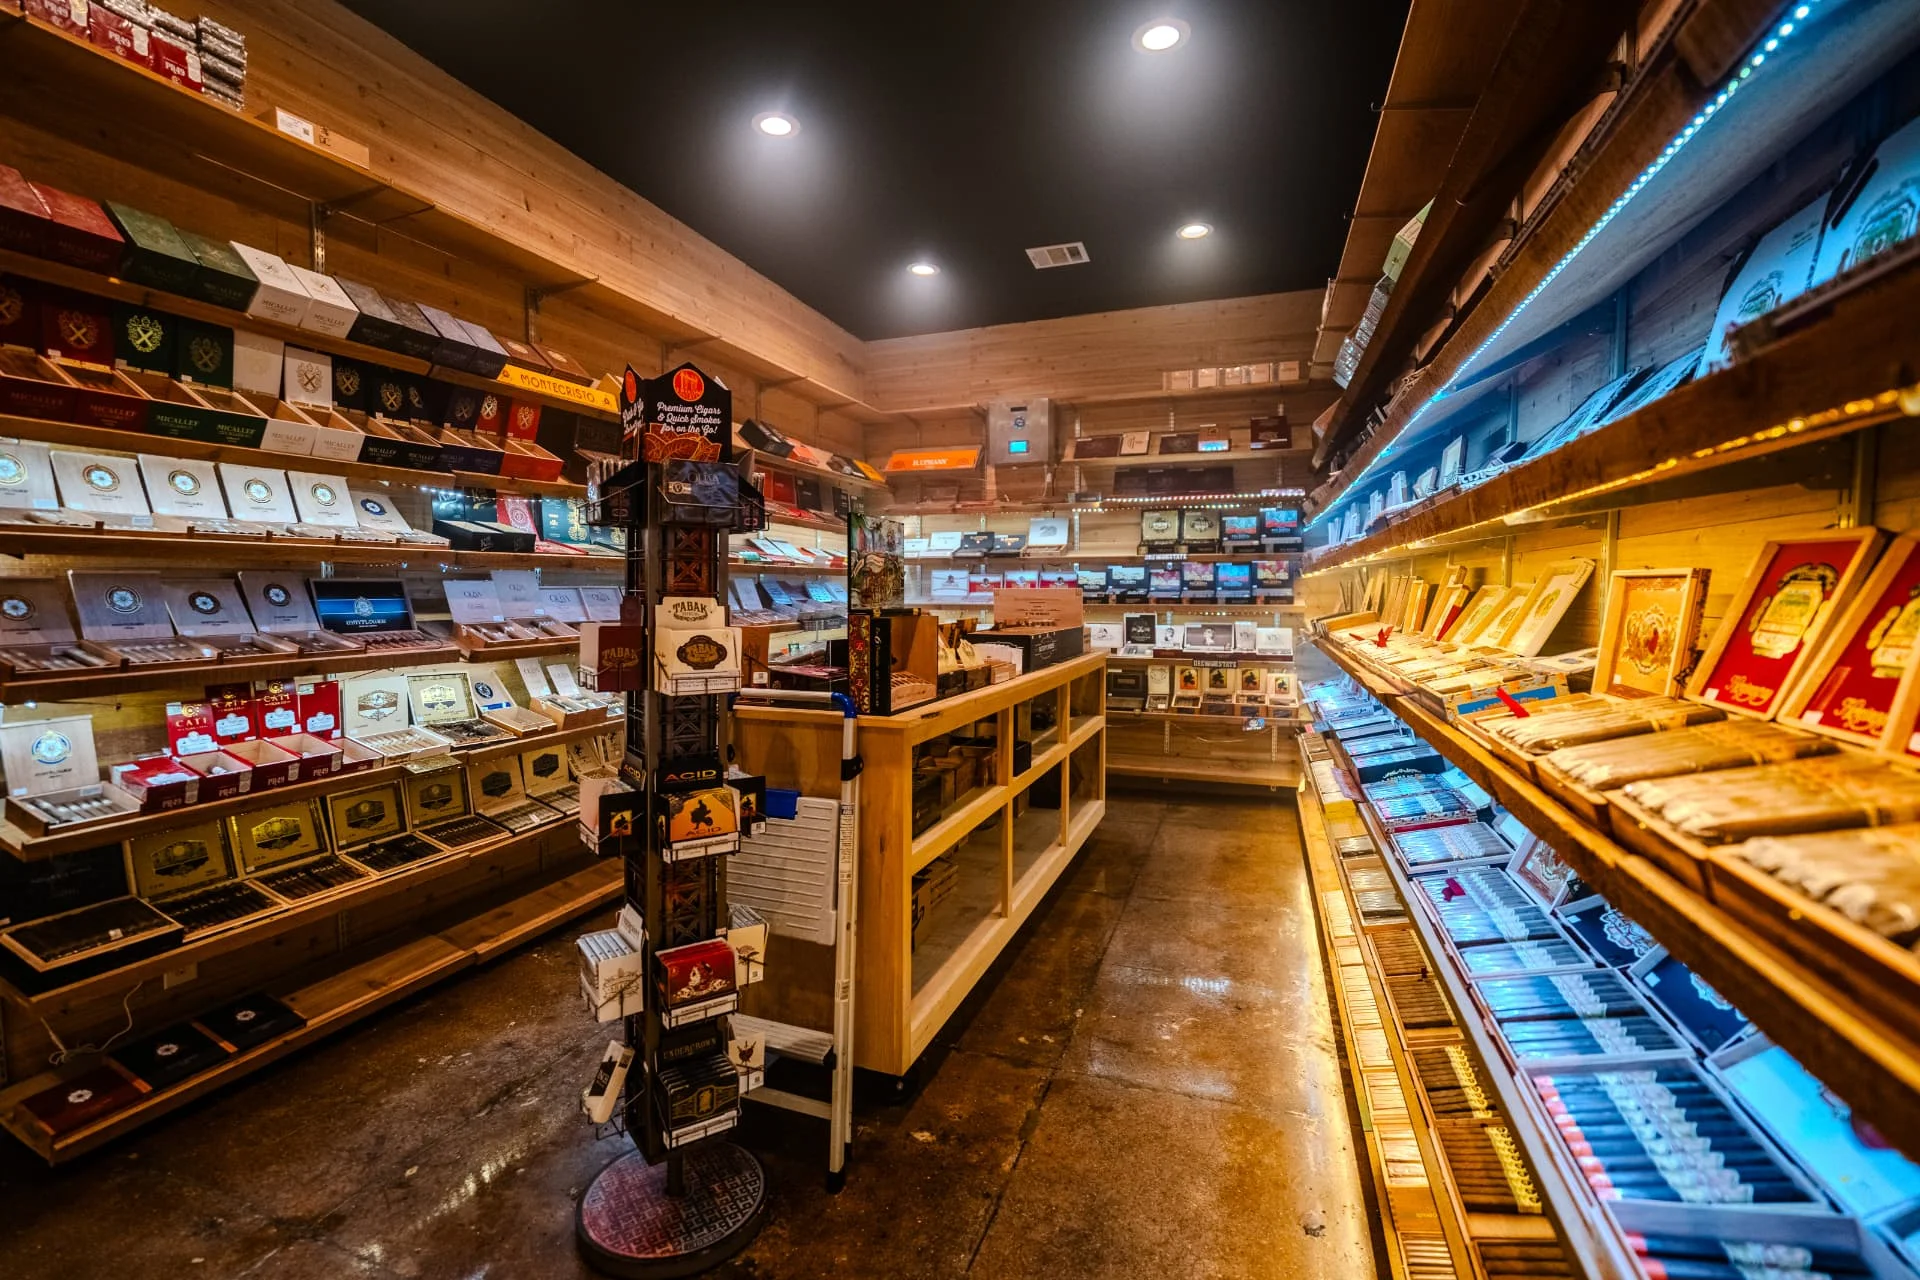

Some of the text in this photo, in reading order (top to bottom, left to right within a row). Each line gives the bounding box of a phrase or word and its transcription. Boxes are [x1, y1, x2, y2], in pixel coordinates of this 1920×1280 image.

[520, 373, 595, 403] MONTECRISTO
[657, 401, 722, 415] Premium Cigars
[155, 414, 200, 428] MICALLEF
[657, 413, 722, 426] & Quick Smokes
[216, 423, 257, 436] MICALLEF
[660, 423, 718, 436] for on the Go!
[672, 601, 707, 613] TABAK
[623, 764, 641, 779] ACID
[664, 769, 717, 783] ACID
[686, 826, 722, 836] ACID
